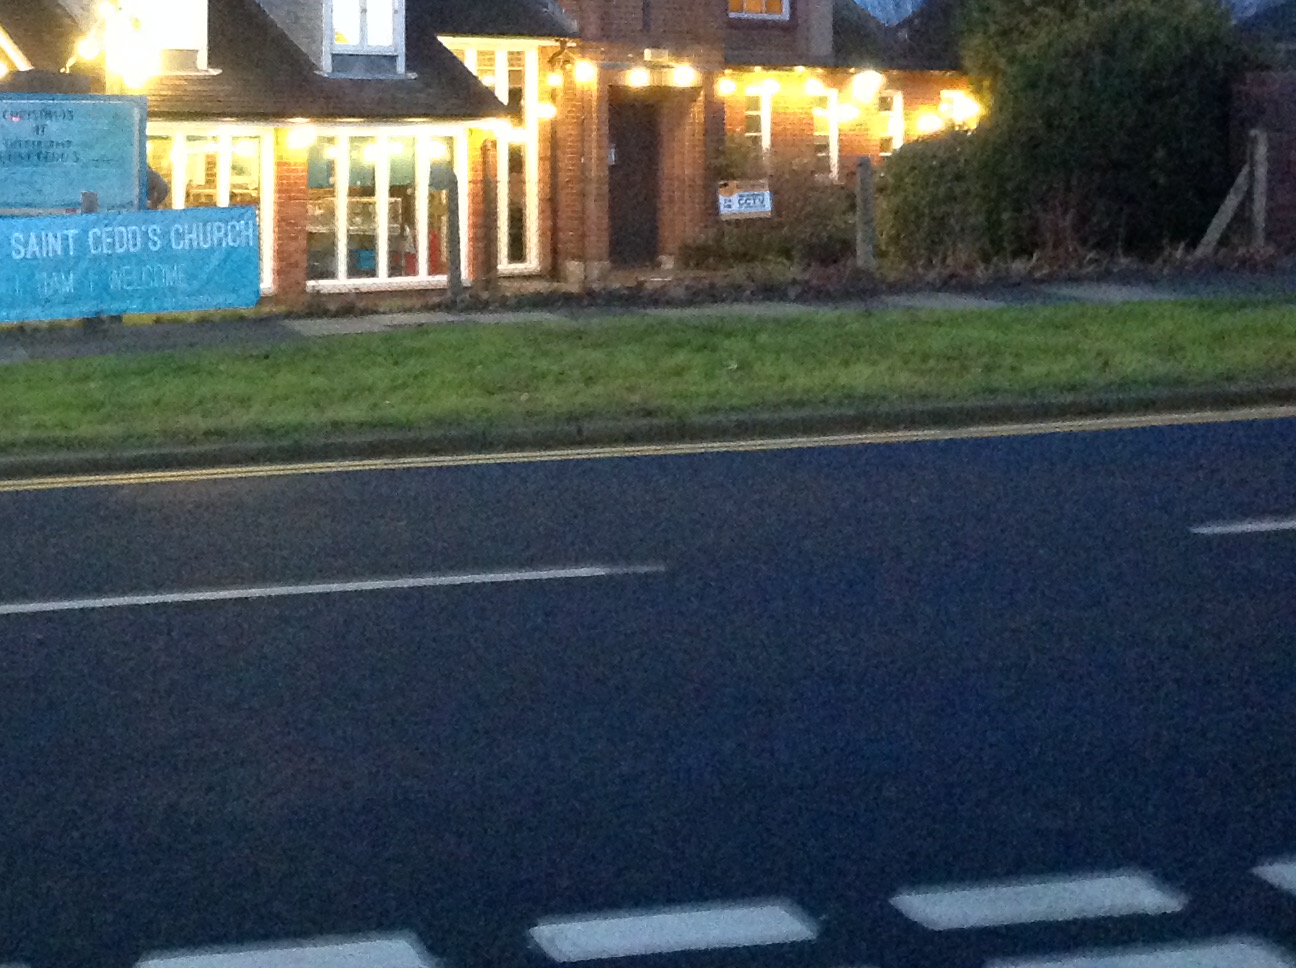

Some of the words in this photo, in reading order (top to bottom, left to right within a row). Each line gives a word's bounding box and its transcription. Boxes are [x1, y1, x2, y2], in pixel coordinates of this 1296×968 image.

[11, 229, 79, 260] SAINT
[88, 224, 163, 254] CEDD'S
[170, 220, 253, 250] CHURCH
